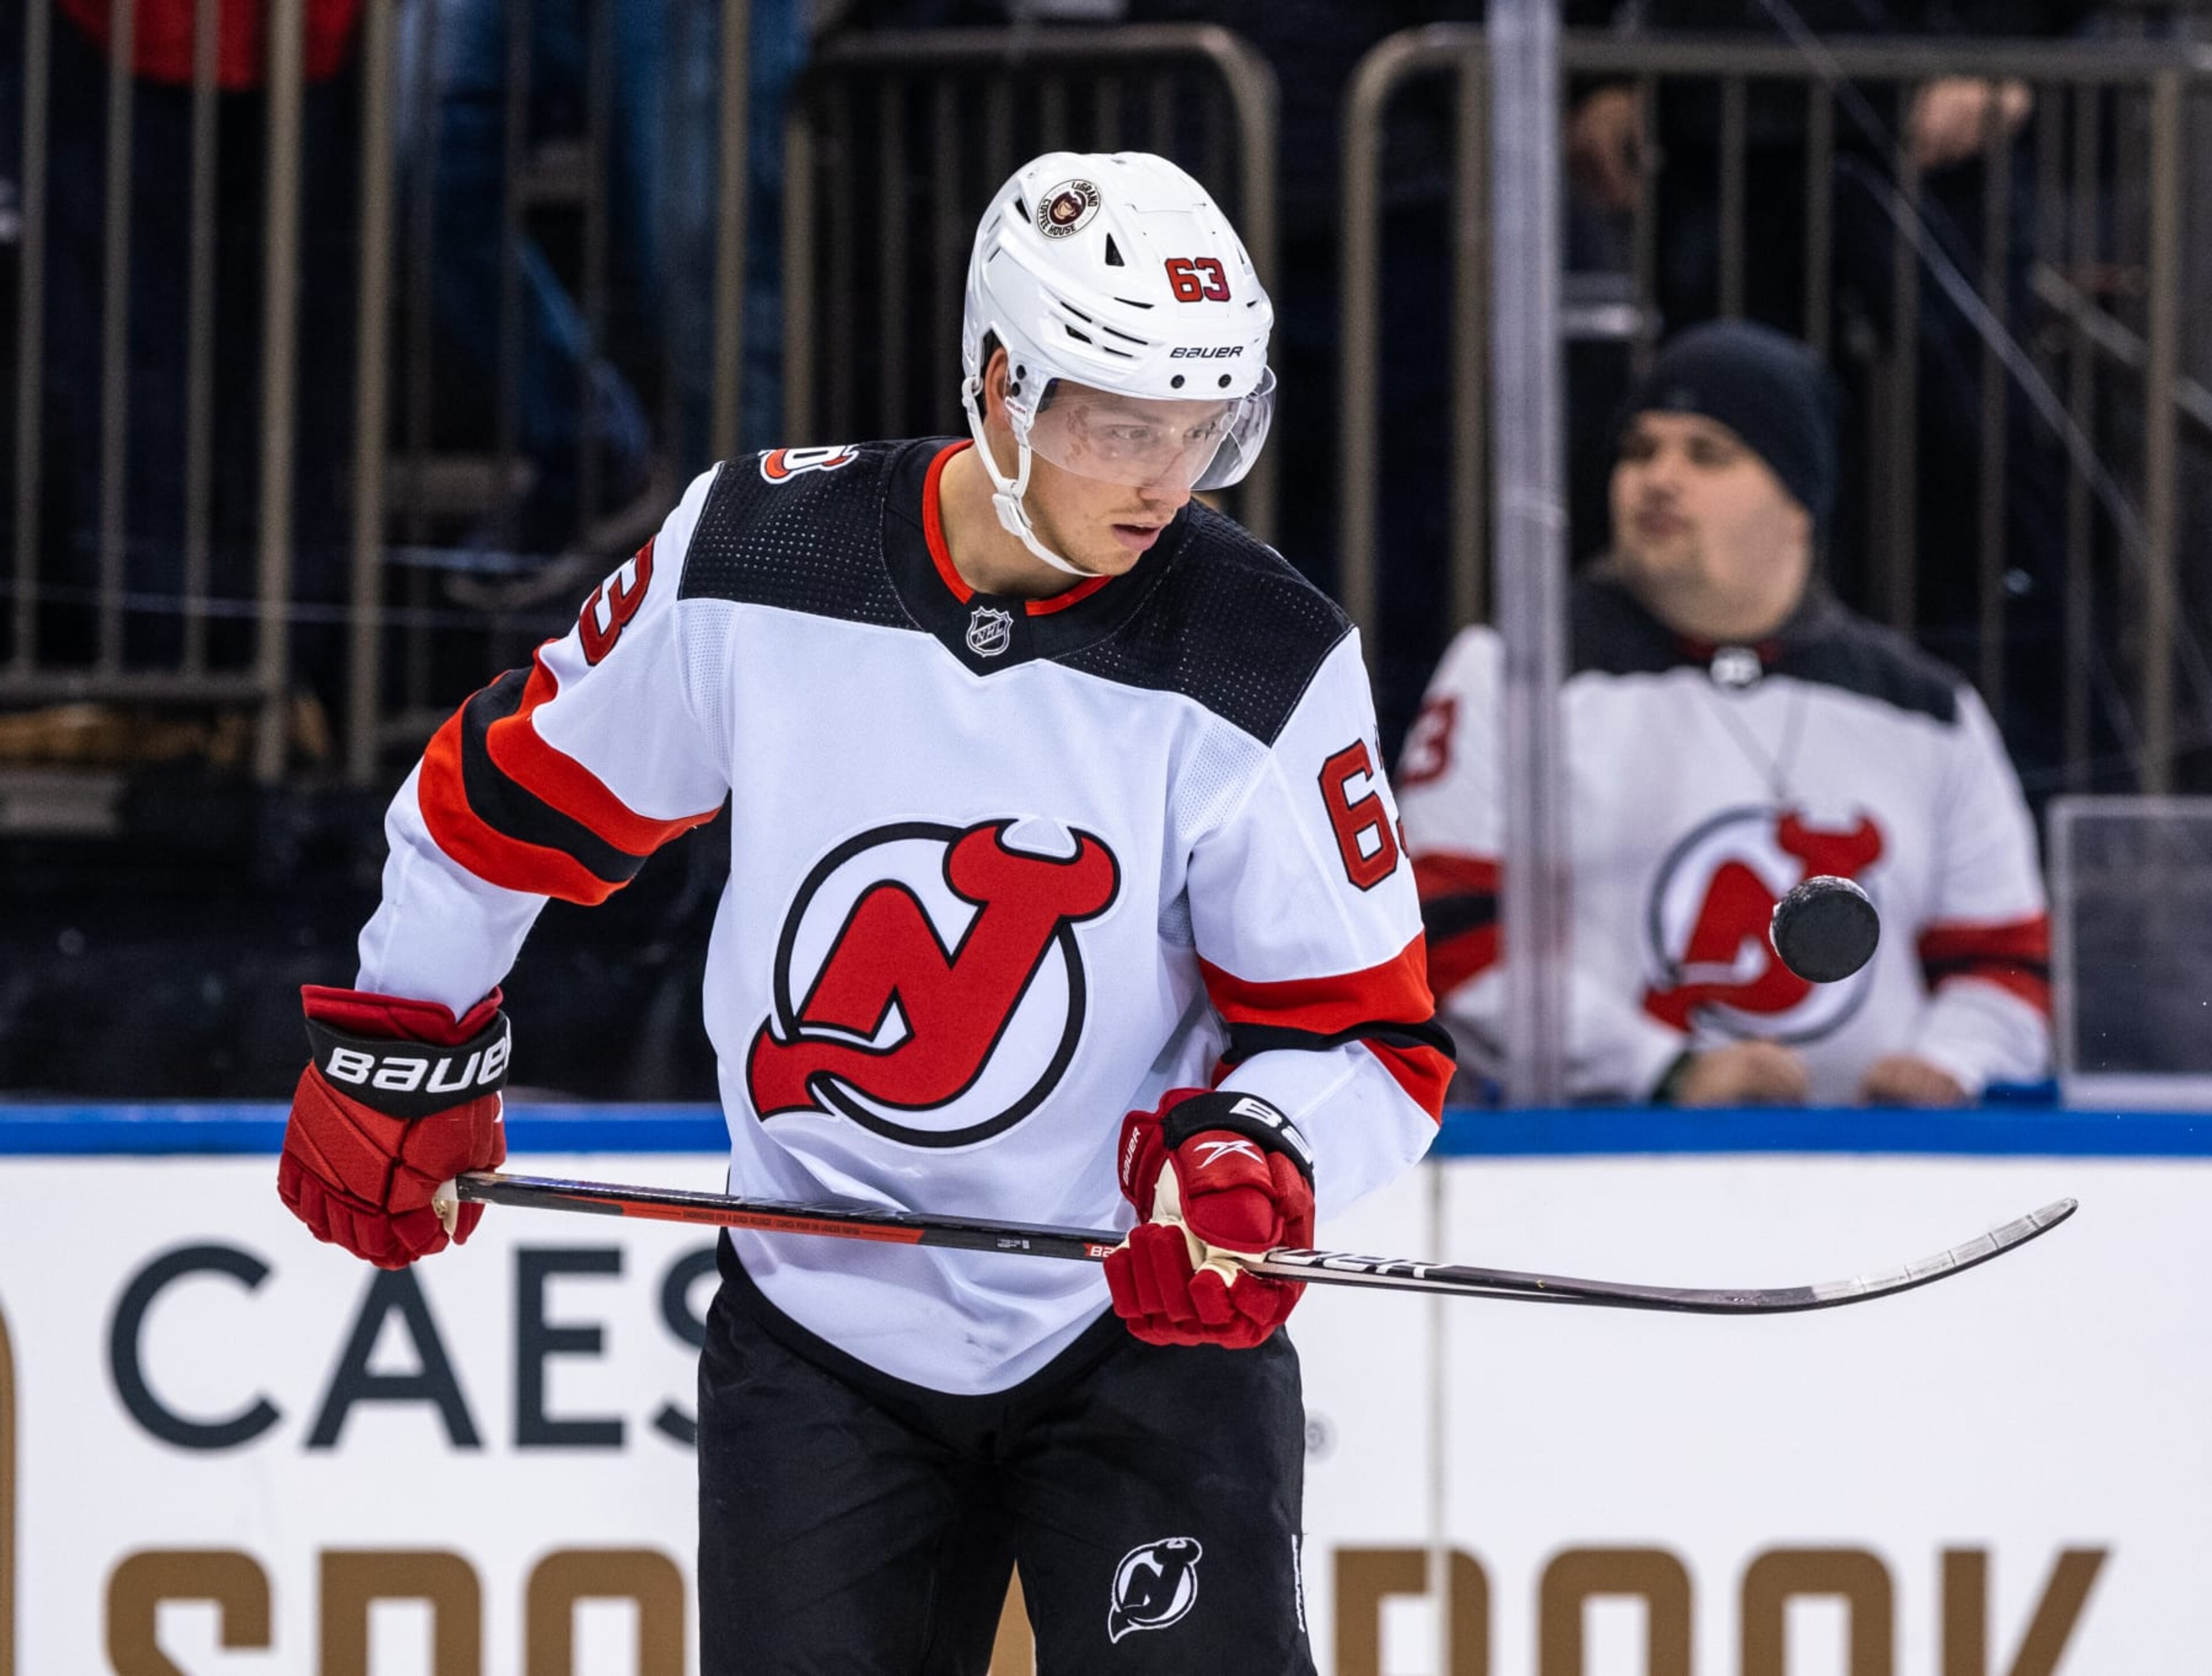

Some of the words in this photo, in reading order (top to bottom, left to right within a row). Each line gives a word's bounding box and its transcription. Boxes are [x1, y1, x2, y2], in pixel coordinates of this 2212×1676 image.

[1039, 198, 1052, 230] COFFEE
[1048, 223, 1077, 236] HOUSE
[1165, 257, 1231, 302] 63
[1169, 346, 1244, 358] BAUER
[975, 621, 1004, 645] NHL
[1317, 724, 1410, 892] 6
[325, 1017, 512, 1093] BAUE
